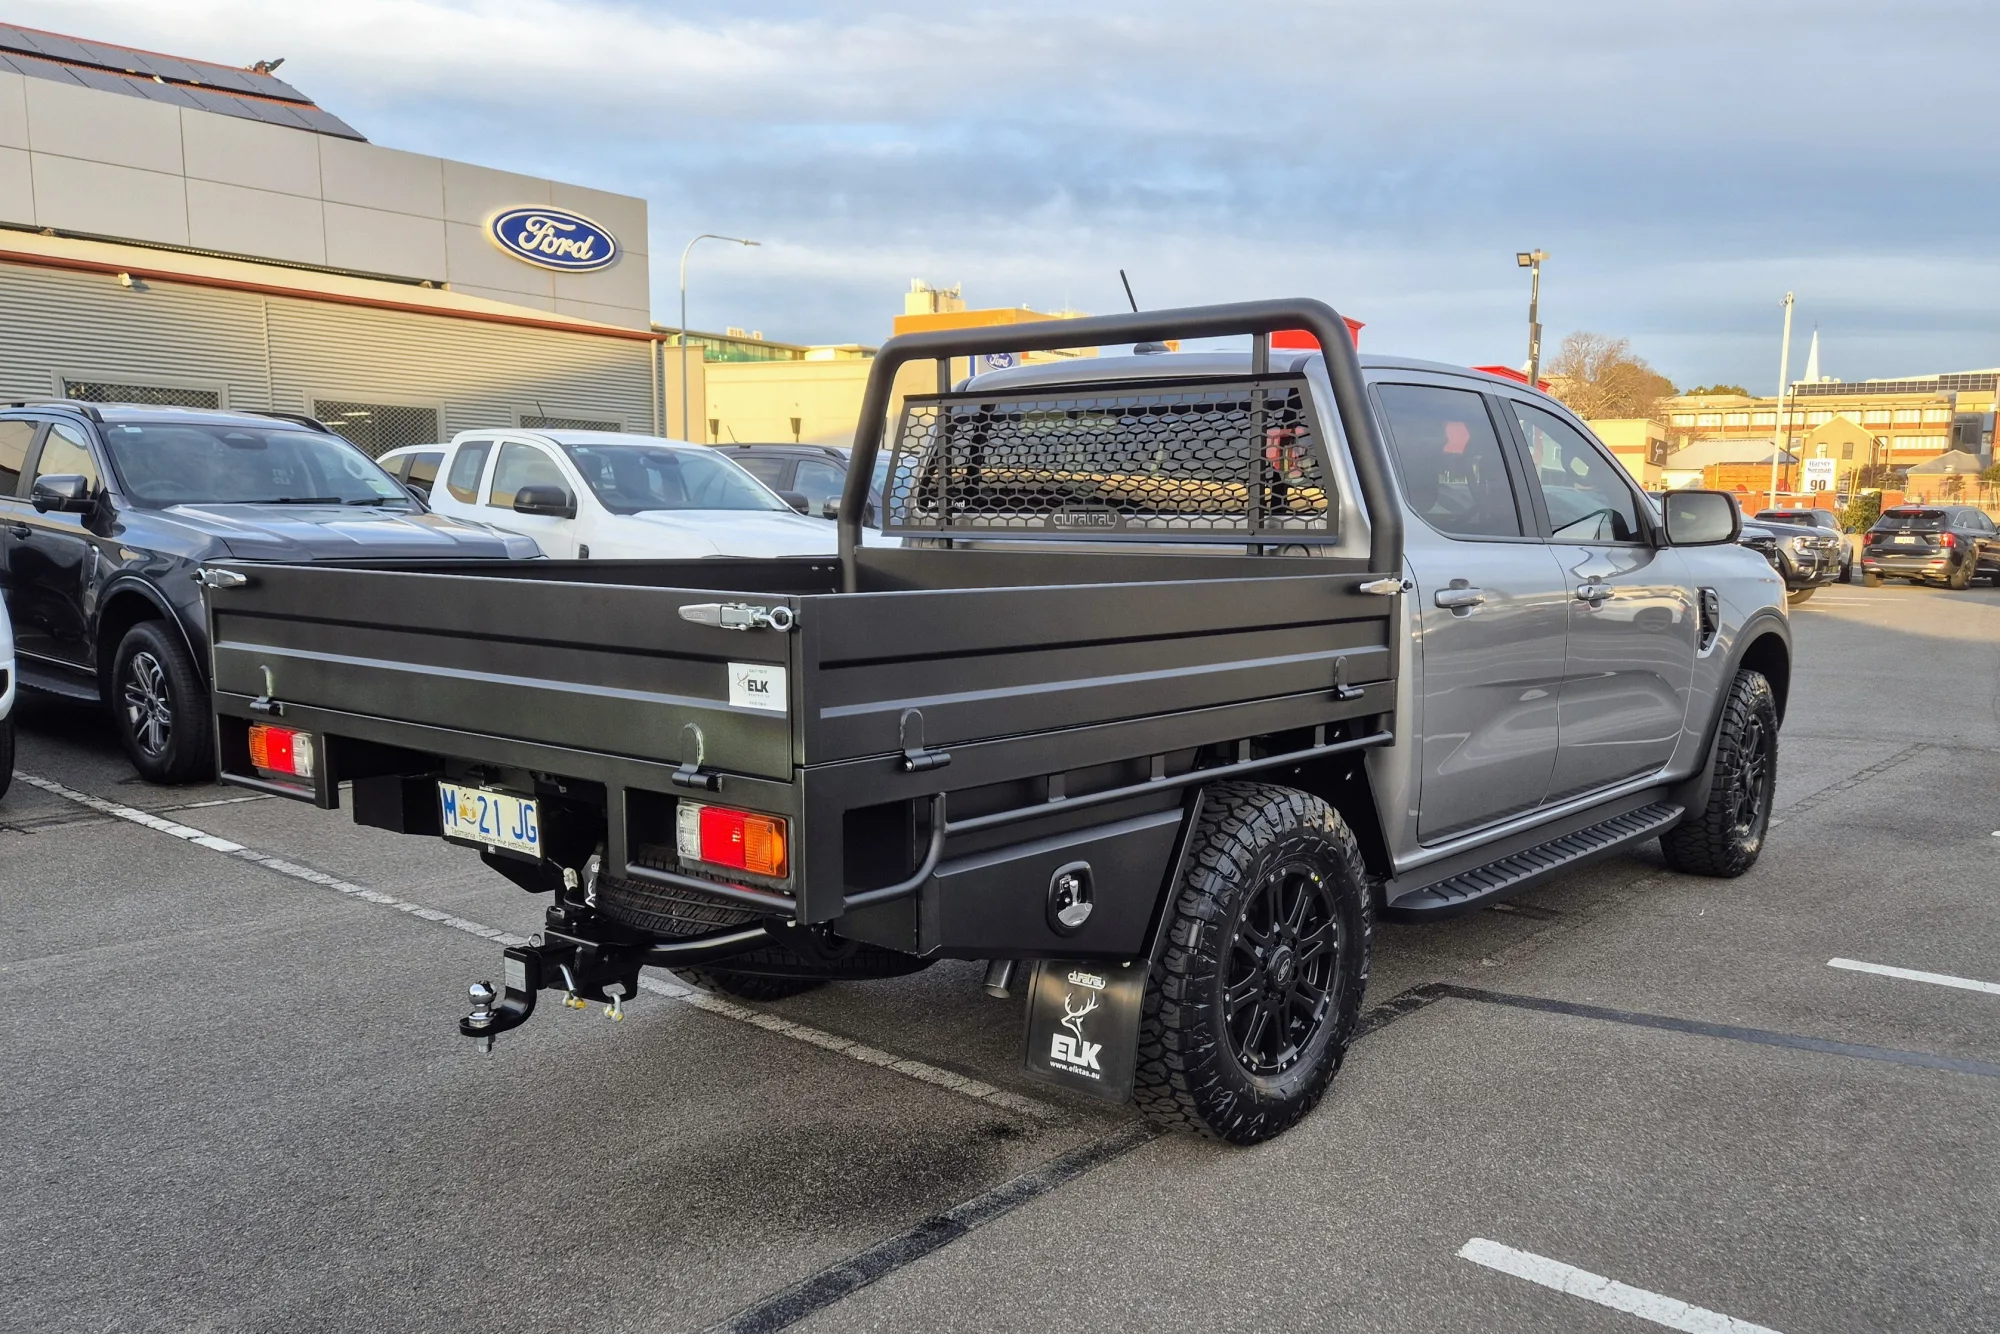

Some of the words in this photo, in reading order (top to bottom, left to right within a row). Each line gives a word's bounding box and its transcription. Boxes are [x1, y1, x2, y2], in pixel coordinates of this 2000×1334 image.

[518, 216, 595, 260] Ford
[989, 352, 1010, 368] Ford
[1810, 479, 1826, 491] 90
[747, 679, 769, 693] ELK
[442, 788, 457, 826] M
[477, 796, 501, 837] 21
[512, 802, 537, 843] JG
[451, 827, 476, 839] Tasmania
[1067, 970, 1106, 990] duratray
[1050, 1032, 1102, 1071] ELK
[1049, 1061, 1100, 1080] www.elktas.au
